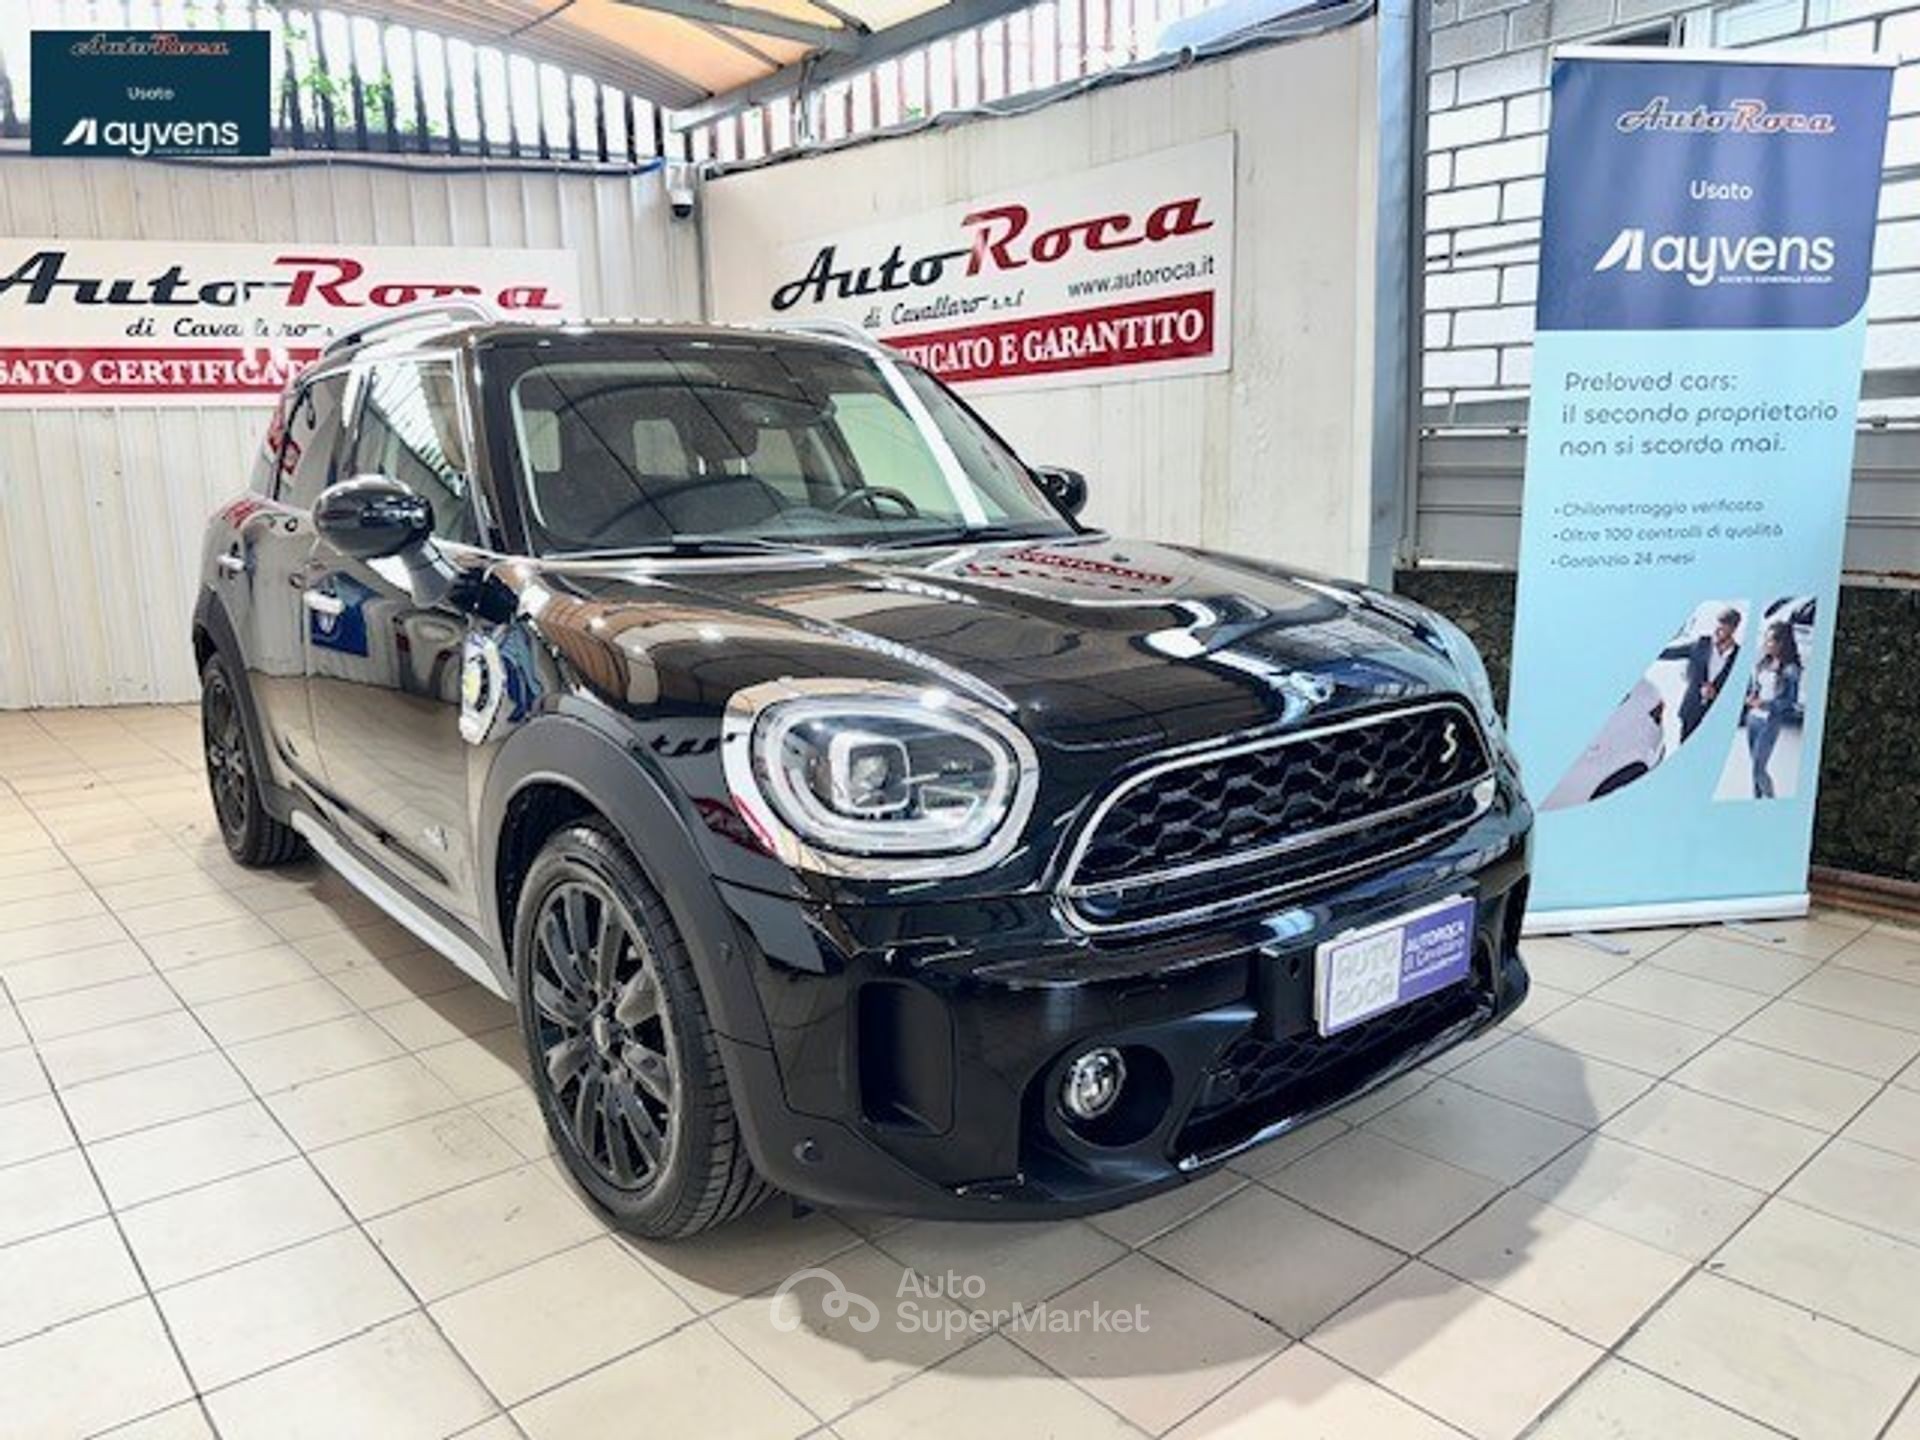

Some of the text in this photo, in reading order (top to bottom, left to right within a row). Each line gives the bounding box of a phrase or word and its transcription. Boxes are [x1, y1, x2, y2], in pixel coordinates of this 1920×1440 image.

[1689, 180, 1753, 200] Usato
[1651, 234, 1835, 286] ayvens
[1068, 255, 1214, 298] www.autoroca.it
[863, 306, 881, 328] di
[891, 294, 989, 326] Cavallaro
[126, 317, 155, 337] di
[1000, 334, 1018, 365] E
[1023, 308, 1205, 363] GARANTITO
[91, 358, 314, 386] CERTIFICAT
[1564, 371, 1739, 392] Preloved cars:
[1562, 401, 1838, 427] il secondo proprietario
[1560, 432, 1787, 456] non si scorda mai.
[1562, 498, 1765, 518] Chilometraggio verificato
[1560, 527, 1600, 542] Oltre
[1605, 527, 1633, 541] 100
[1638, 525, 1701, 541] controlli
[1707, 523, 1720, 538] di
[1557, 549, 1696, 568] Garanzia 24 mesi
